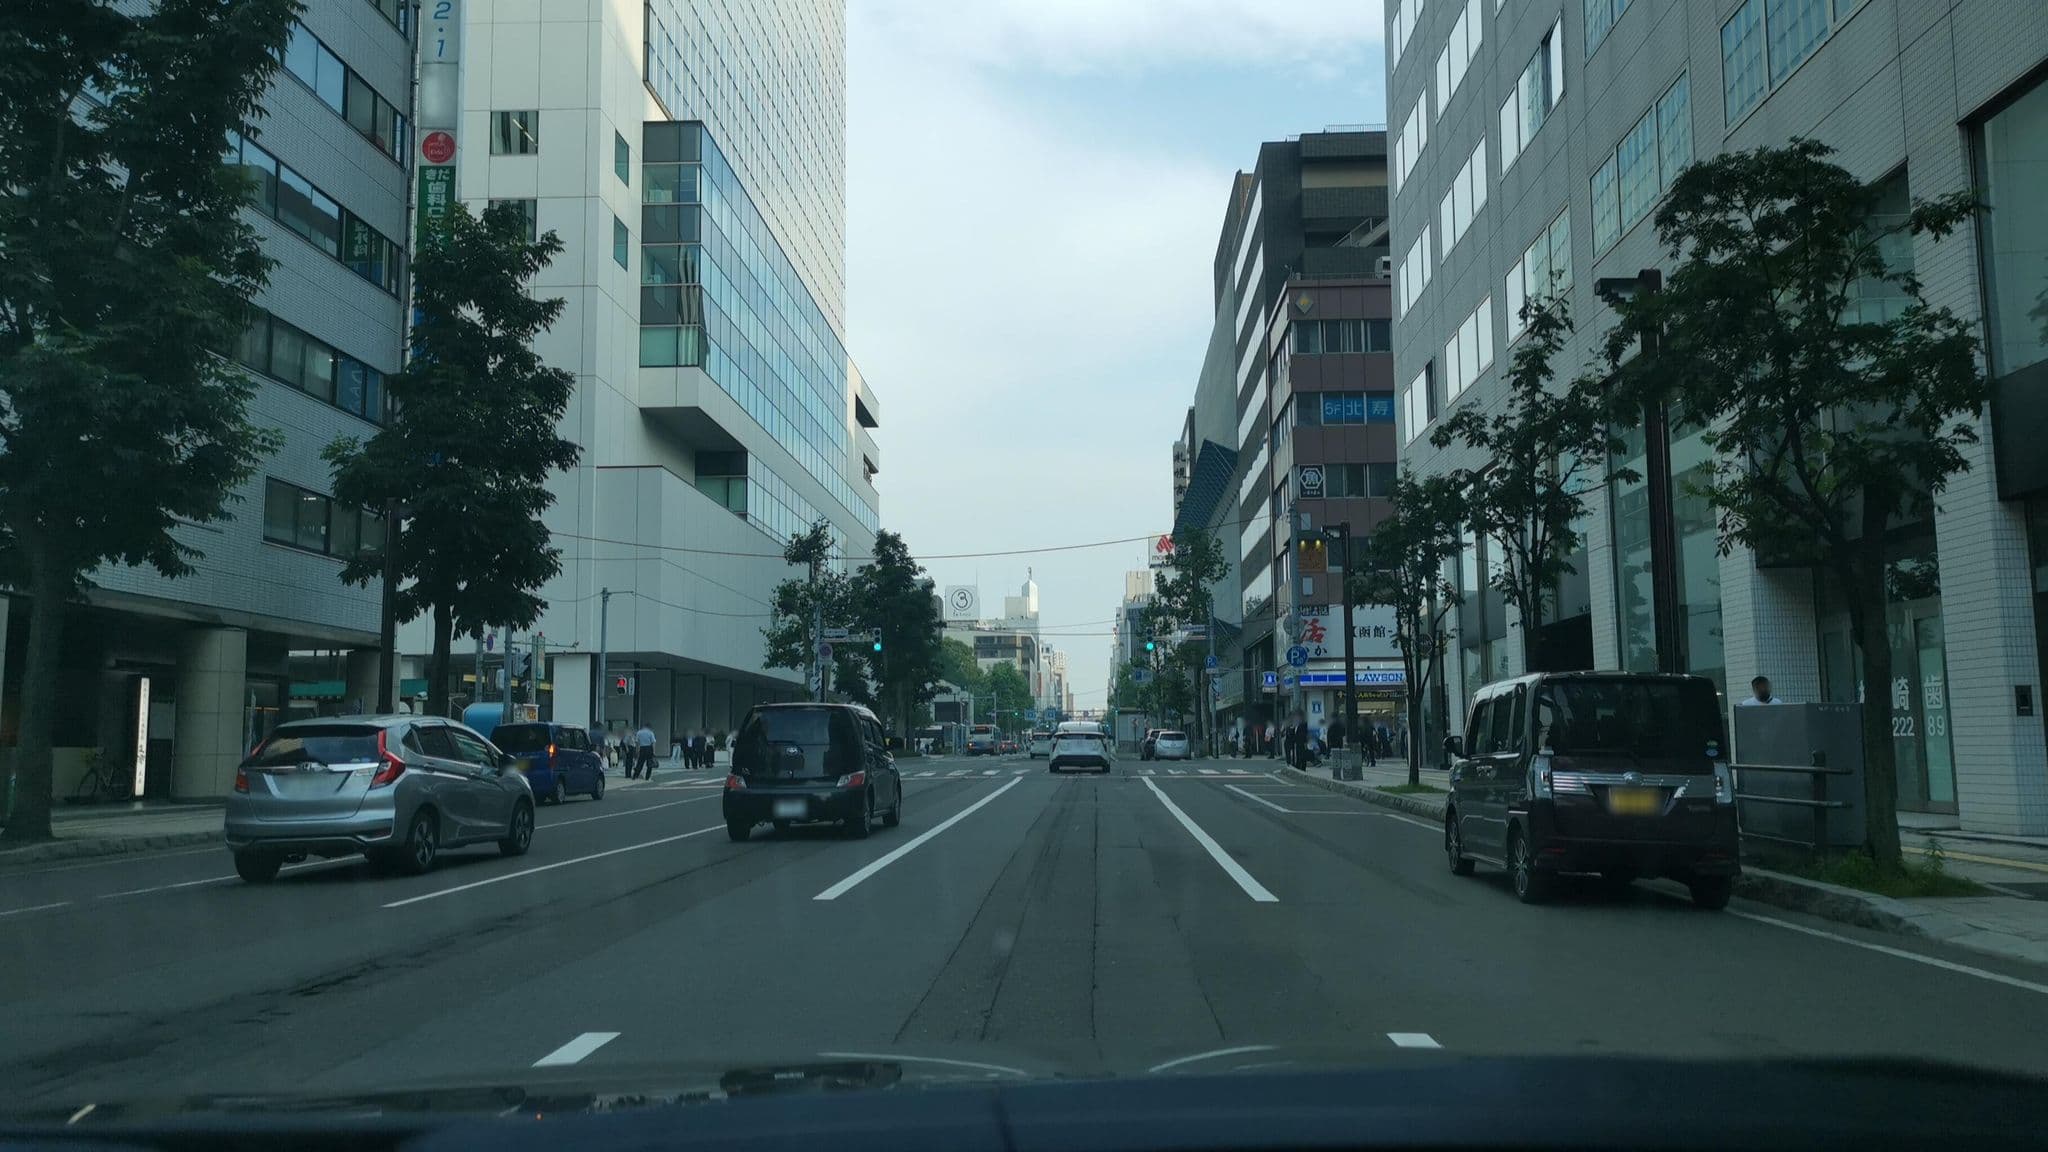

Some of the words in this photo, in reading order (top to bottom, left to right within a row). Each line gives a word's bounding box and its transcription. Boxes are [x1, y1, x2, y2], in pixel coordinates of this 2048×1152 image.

[1355, 673, 1404, 682] LAWSON
[1891, 716, 1915, 737] 222
[1927, 715, 1945, 737] 89
